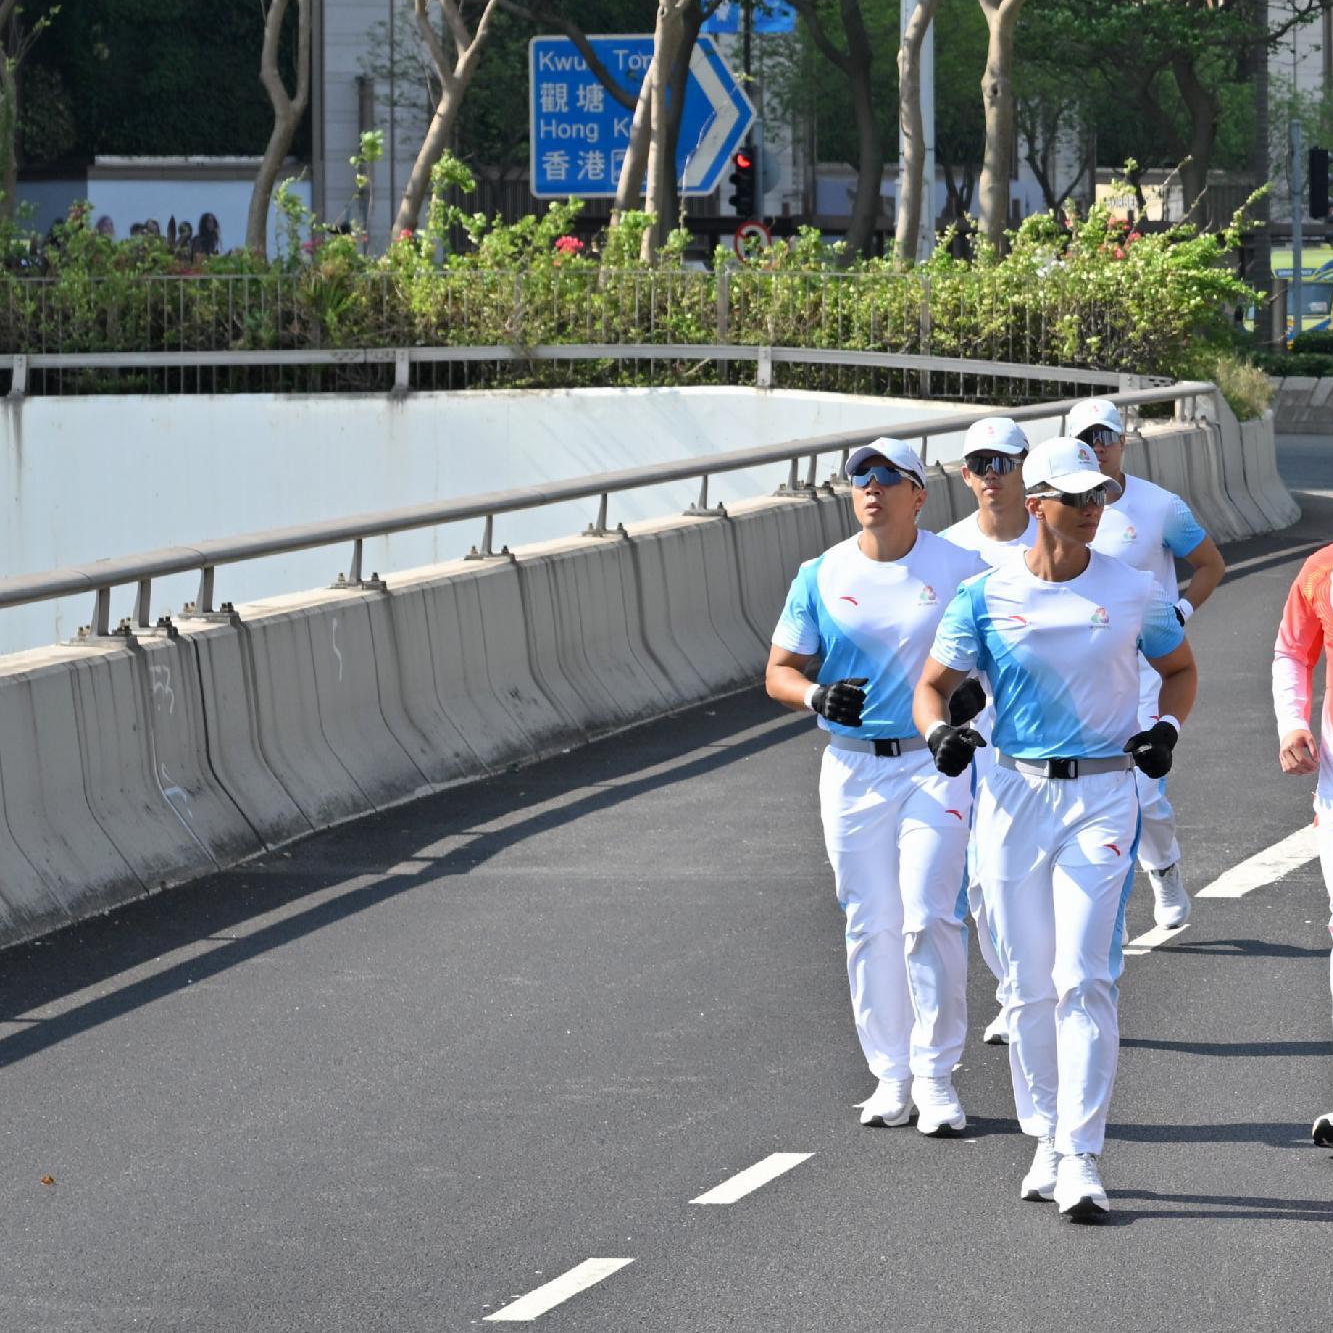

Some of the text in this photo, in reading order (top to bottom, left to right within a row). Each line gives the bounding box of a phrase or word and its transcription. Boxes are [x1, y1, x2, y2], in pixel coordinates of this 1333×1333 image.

[539, 50, 592, 72] Kwu
[540, 83, 605, 113] 觀塘
[540, 118, 600, 143] Hong
[542, 150, 605, 181] 香港
